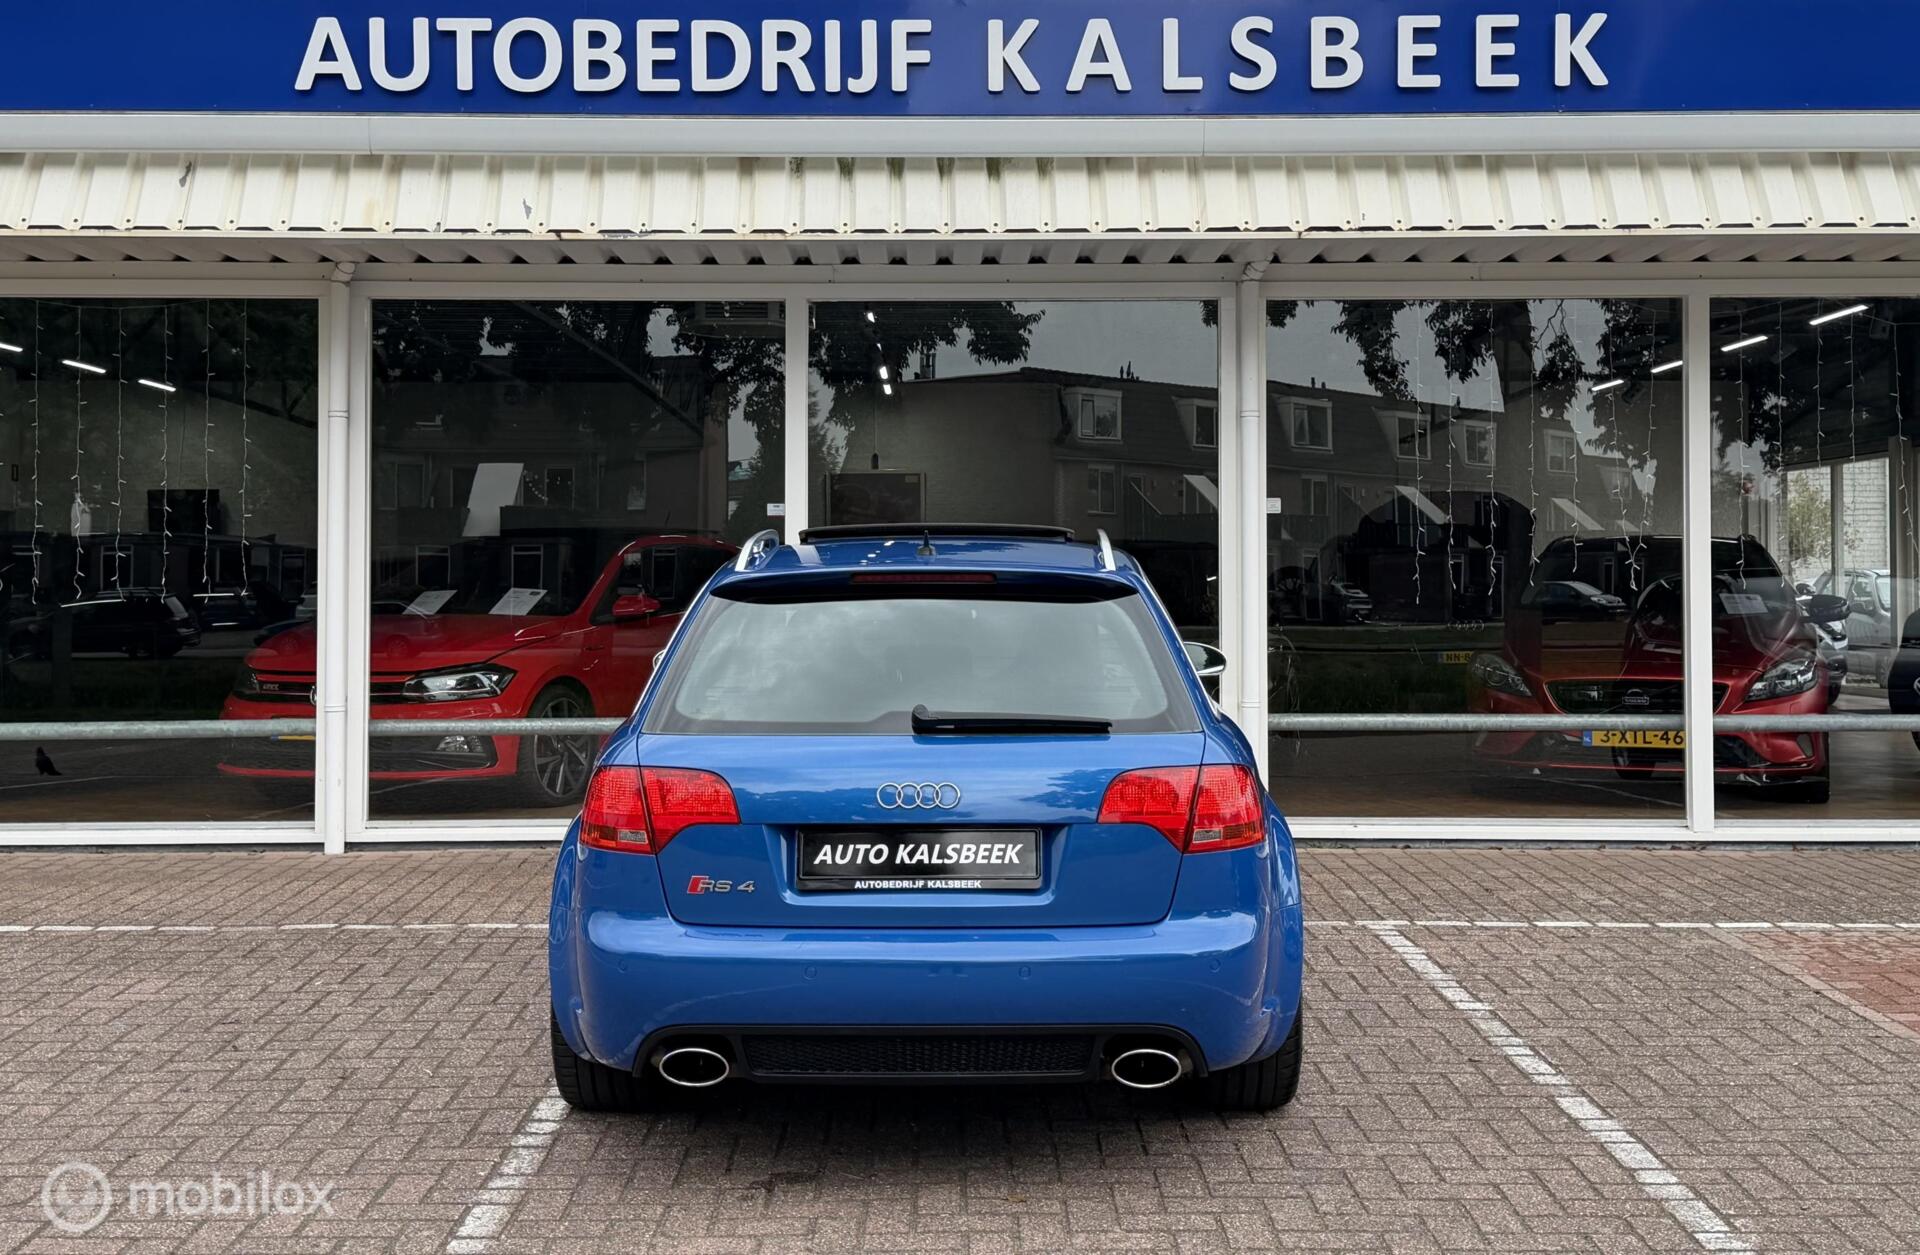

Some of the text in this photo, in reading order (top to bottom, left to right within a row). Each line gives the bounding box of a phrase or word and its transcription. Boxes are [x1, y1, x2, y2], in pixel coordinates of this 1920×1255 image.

[294, 12, 1610, 93] AUTOBEDRIJF KALSBEEK
[813, 843, 1024, 865] AUTO KALSBEEK
[694, 878, 755, 893] RS 4
[854, 880, 982, 888] AUTOBEDRIJF KALSBEEK
